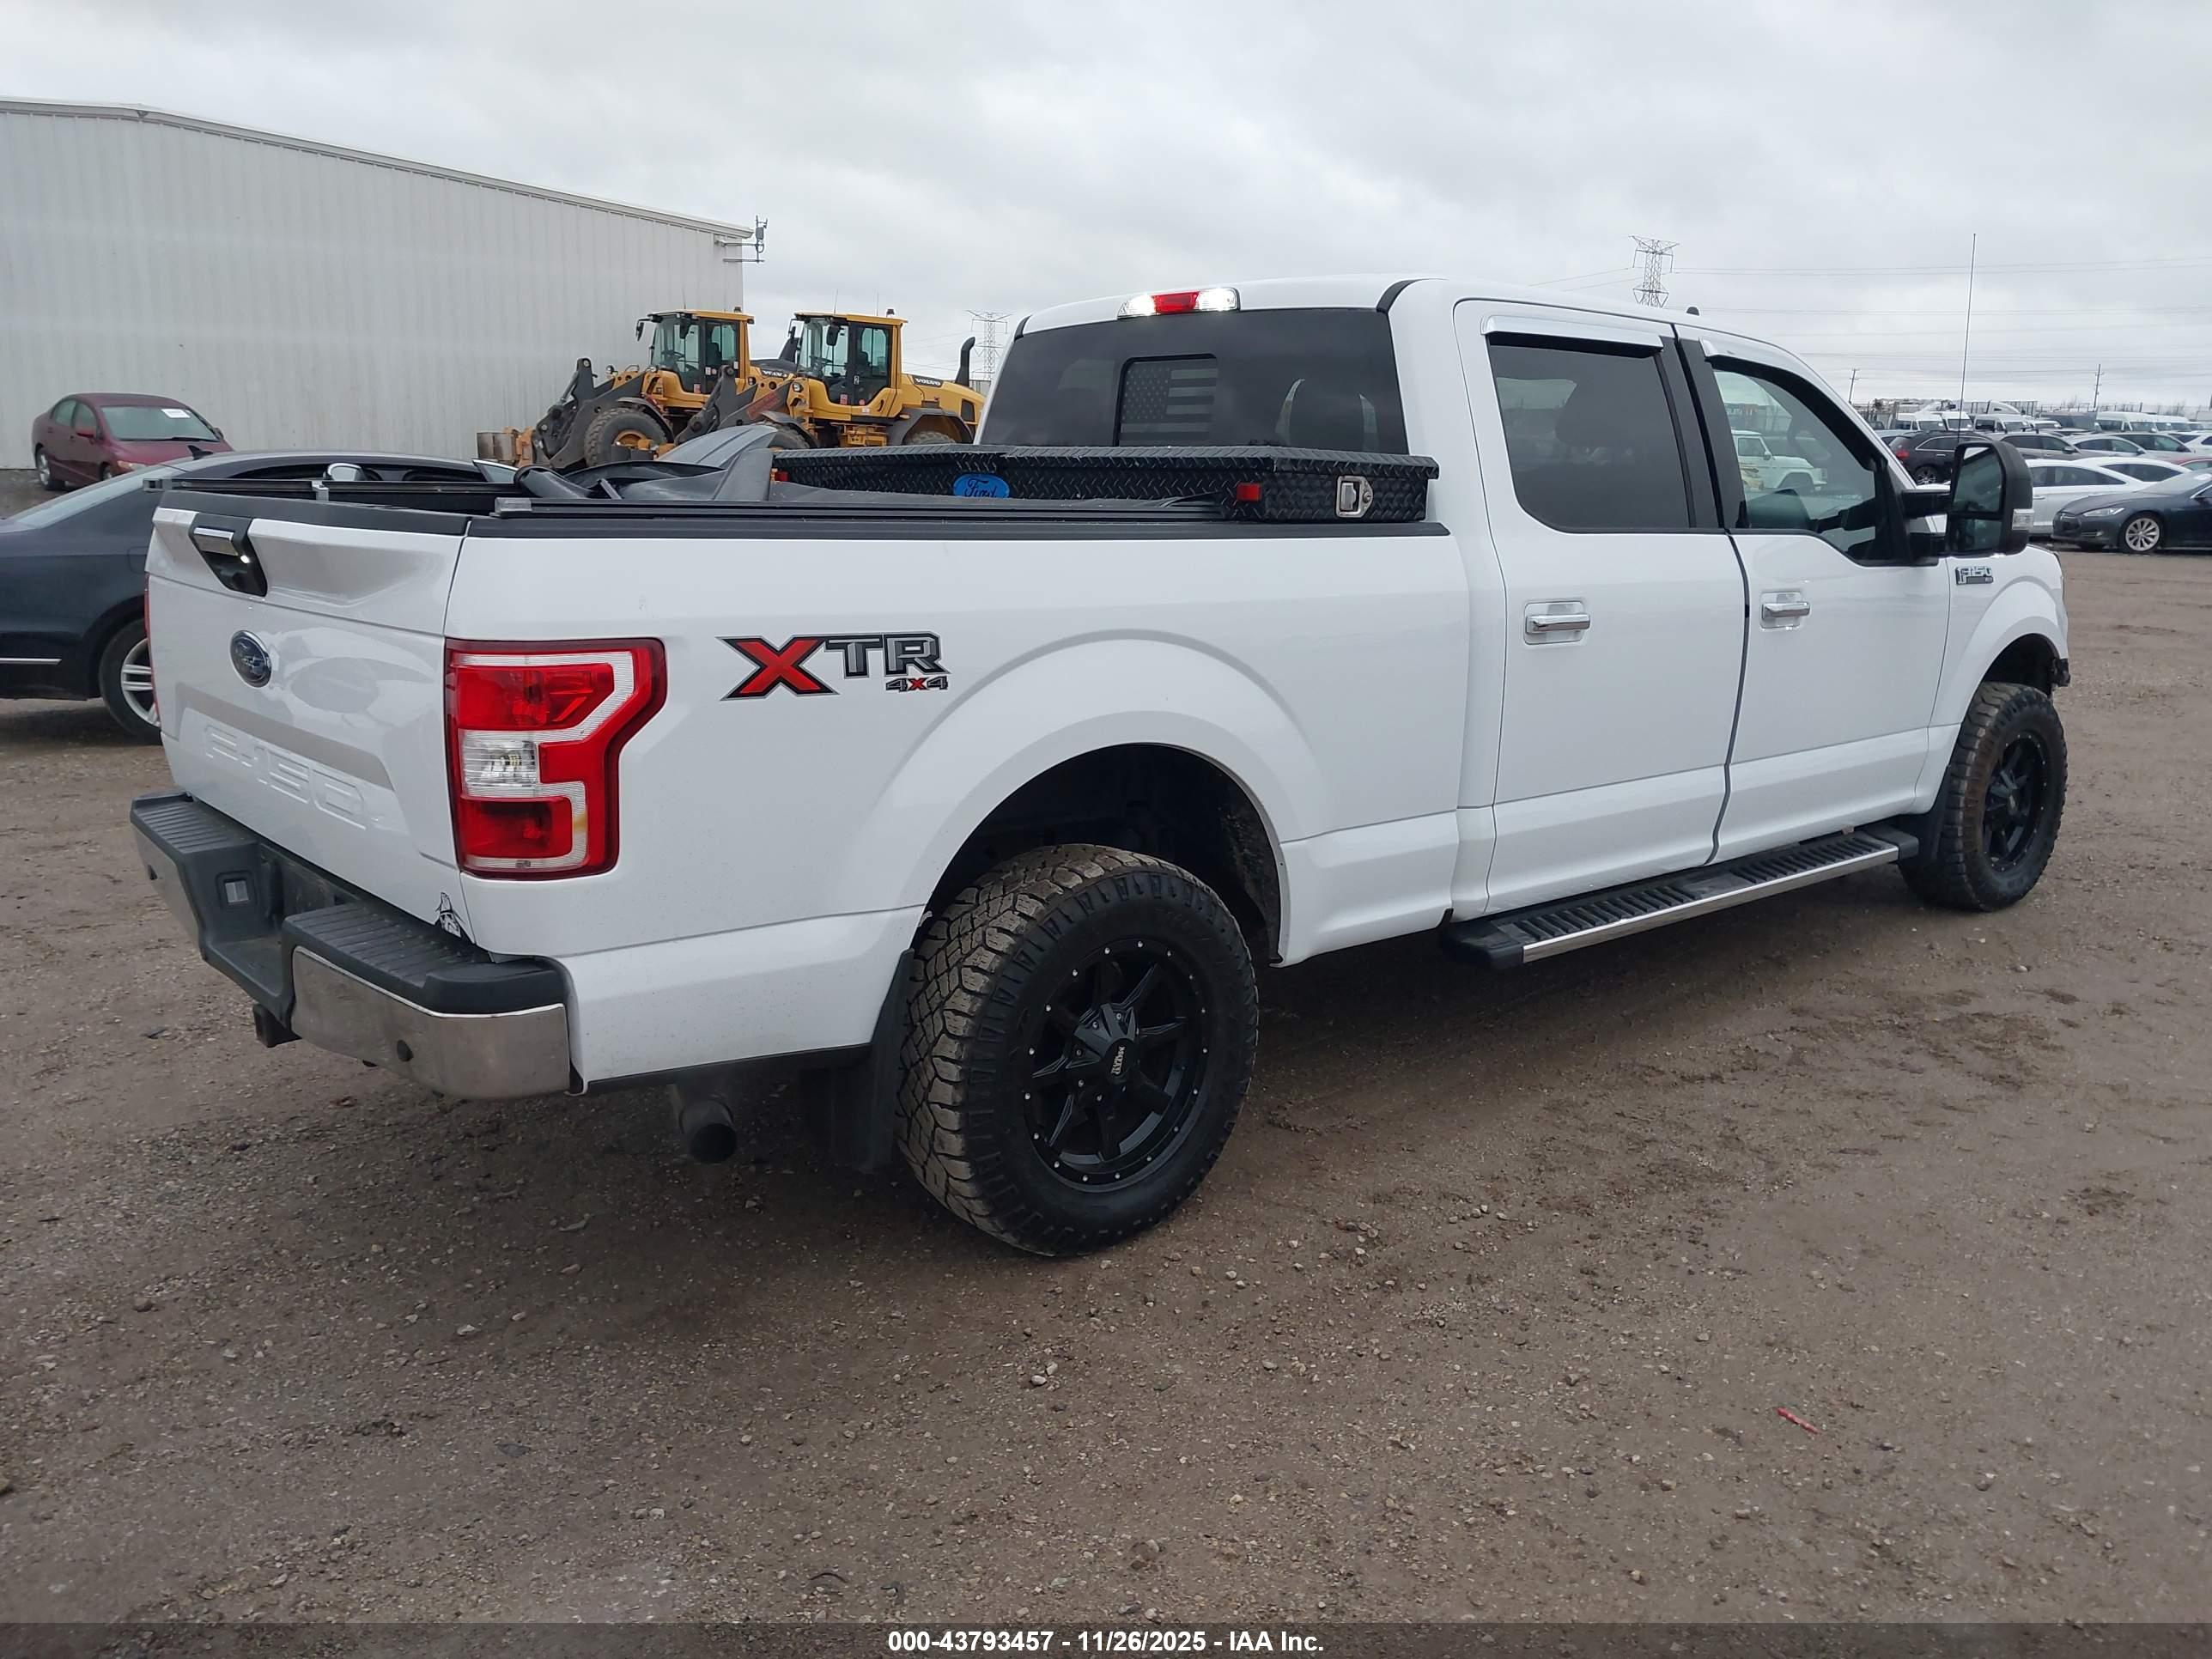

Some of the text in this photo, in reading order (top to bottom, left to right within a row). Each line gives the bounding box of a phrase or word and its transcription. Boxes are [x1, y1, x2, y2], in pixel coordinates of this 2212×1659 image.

[915, 378, 941, 386] VOLVO
[963, 477, 998, 498] Ford
[714, 631, 952, 701] XTR
